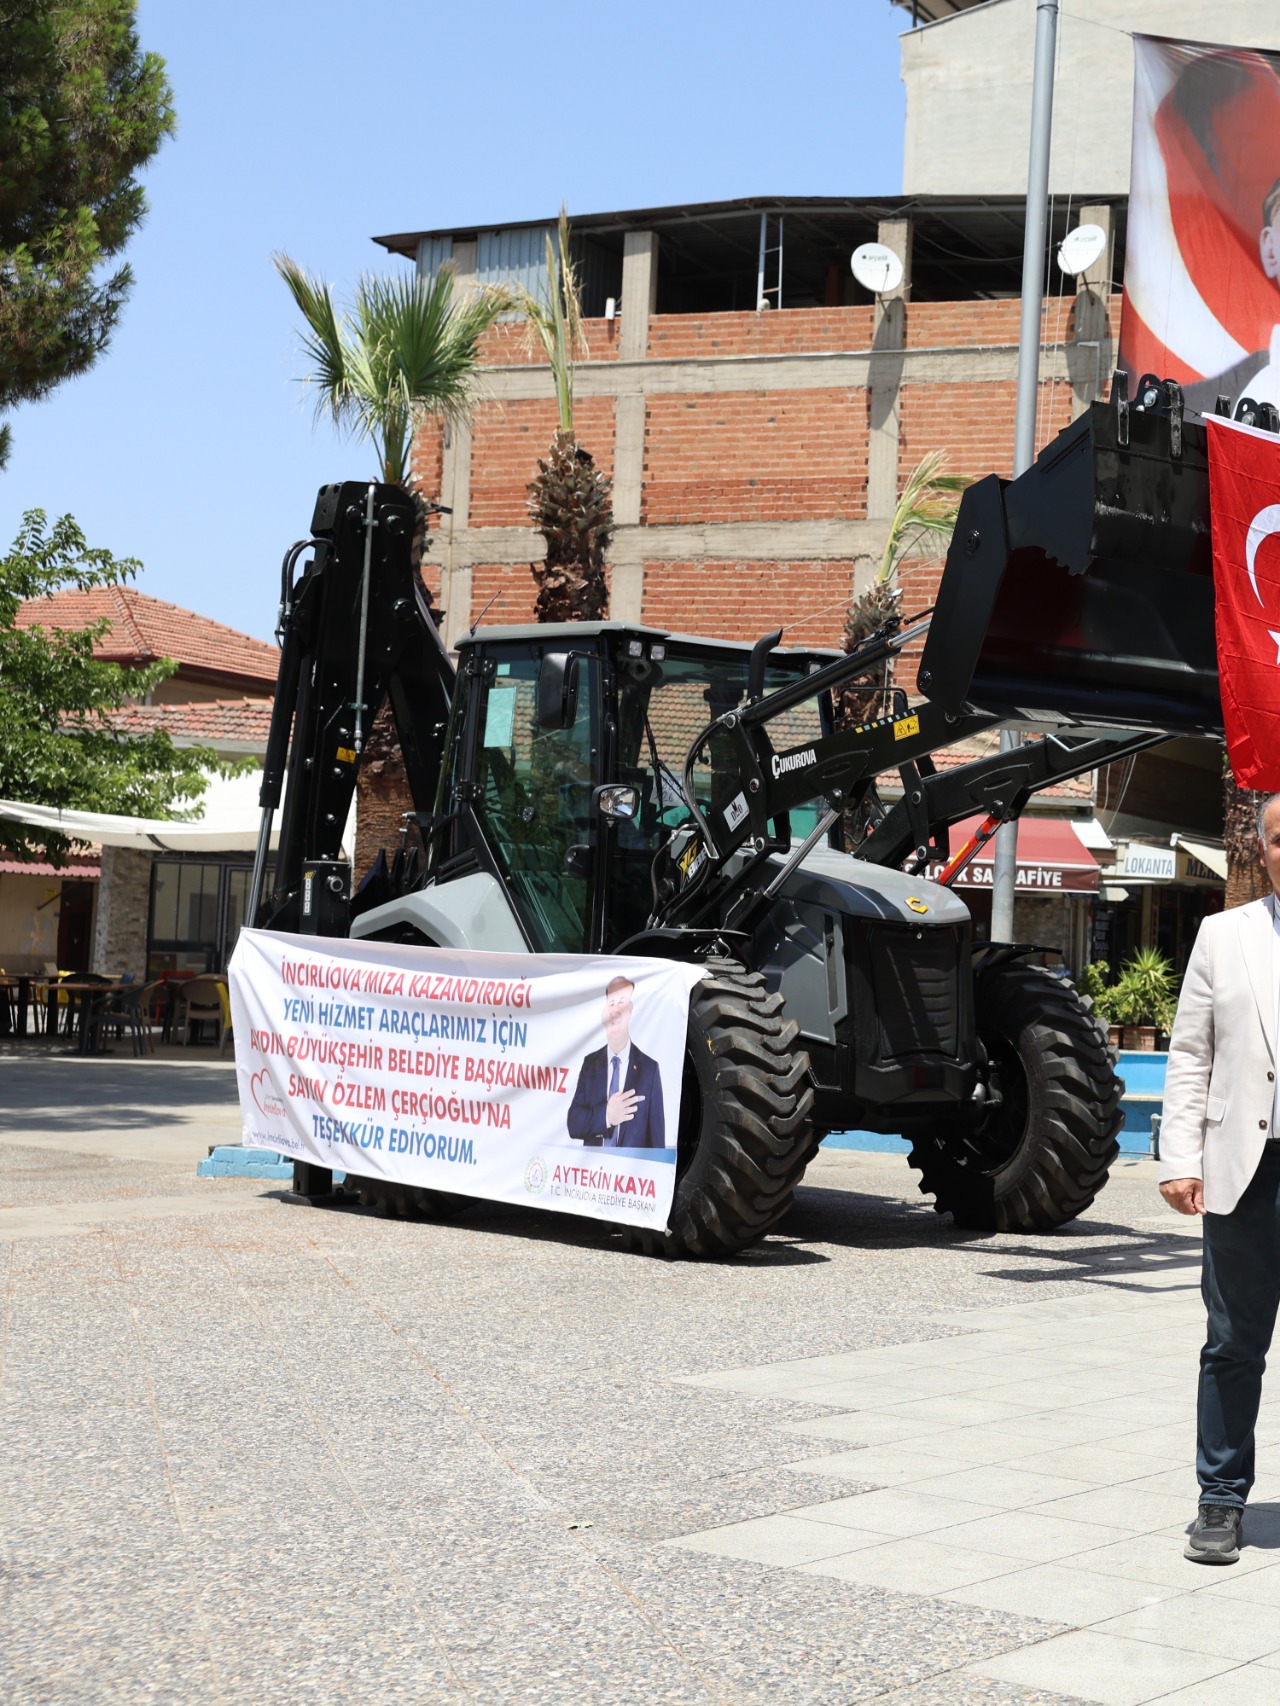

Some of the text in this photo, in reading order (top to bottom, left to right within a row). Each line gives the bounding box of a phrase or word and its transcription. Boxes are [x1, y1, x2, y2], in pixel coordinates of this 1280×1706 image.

[771, 748, 817, 779] ÇUKUROVA
[972, 867, 1062, 887] SAAFİYE
[1124, 857, 1173, 876] LOKANTA
[281, 955, 532, 1008] İNCİRLİOVA'MIZA KAZANDIRDIĞI
[284, 994, 528, 1053] YENİ HİZMET ARAÇLARIMIZ İÇİN
[250, 1028, 570, 1094] AYDIN BÜYÜKŞEHİR BELEDİYE BAŞKANIMIZ
[288, 1073, 511, 1129] SAYIN ÖZLEM ÇERÇİOĞLU'NA
[312, 1114, 477, 1165] TEŞEKKÜR EDİYORUM.
[552, 1165, 656, 1198] AYTEKİN KAYA
[598, 1194, 626, 1208] BELEDİYE
[628, 1198, 656, 1213] BAŞKANI
